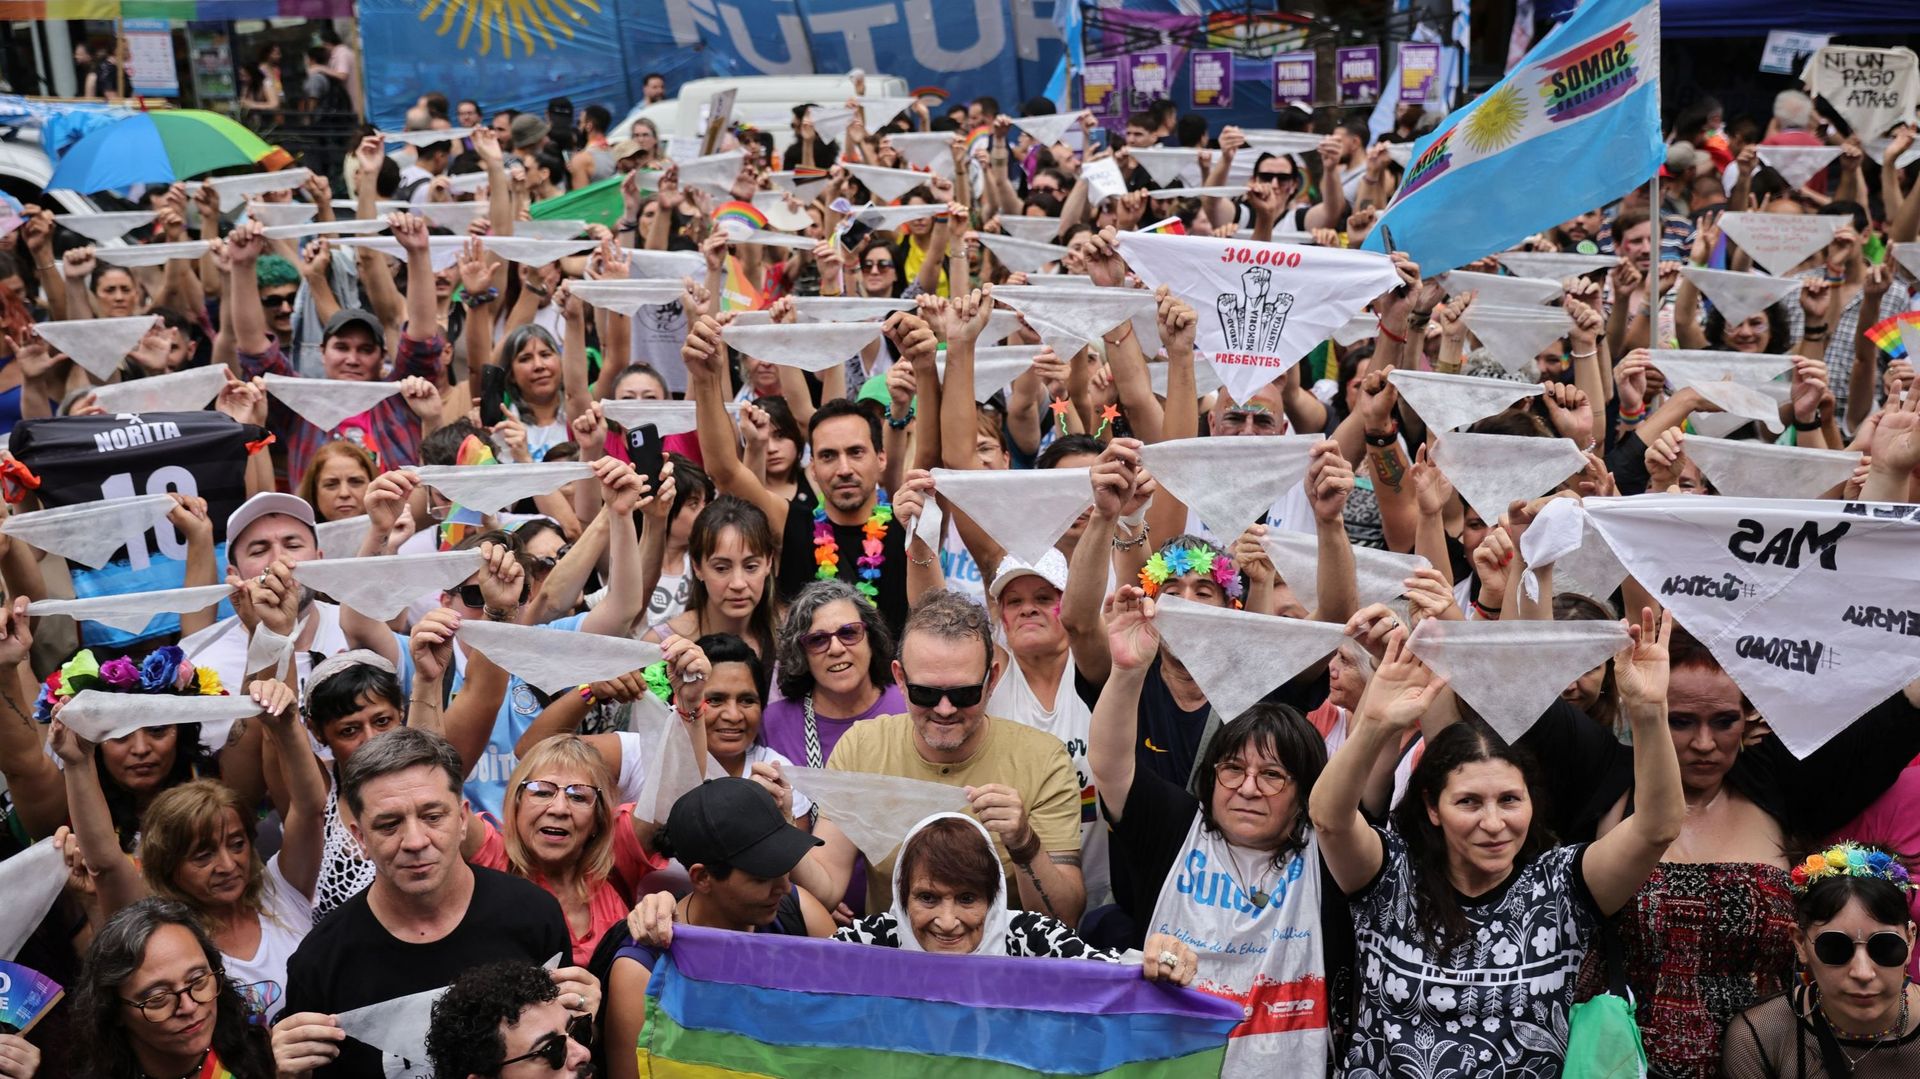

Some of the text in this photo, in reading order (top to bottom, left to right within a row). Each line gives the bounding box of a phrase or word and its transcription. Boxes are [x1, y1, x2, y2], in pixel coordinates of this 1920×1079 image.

[1856, 53, 1885, 68] UN
[1842, 69, 1895, 86] PASO
[1846, 89, 1899, 108] ATRAS
[1221, 247, 1302, 268] 30.000
[1226, 318, 1239, 349] VERDAD
[1245, 310, 1259, 351] MEMORIA
[1266, 316, 1283, 351] JUSTICIA
[1215, 352, 1281, 368] PRESENTES
[93, 421, 182, 452] NORITA
[1209, 941, 1222, 953] de
[1225, 942, 1237, 954] la
